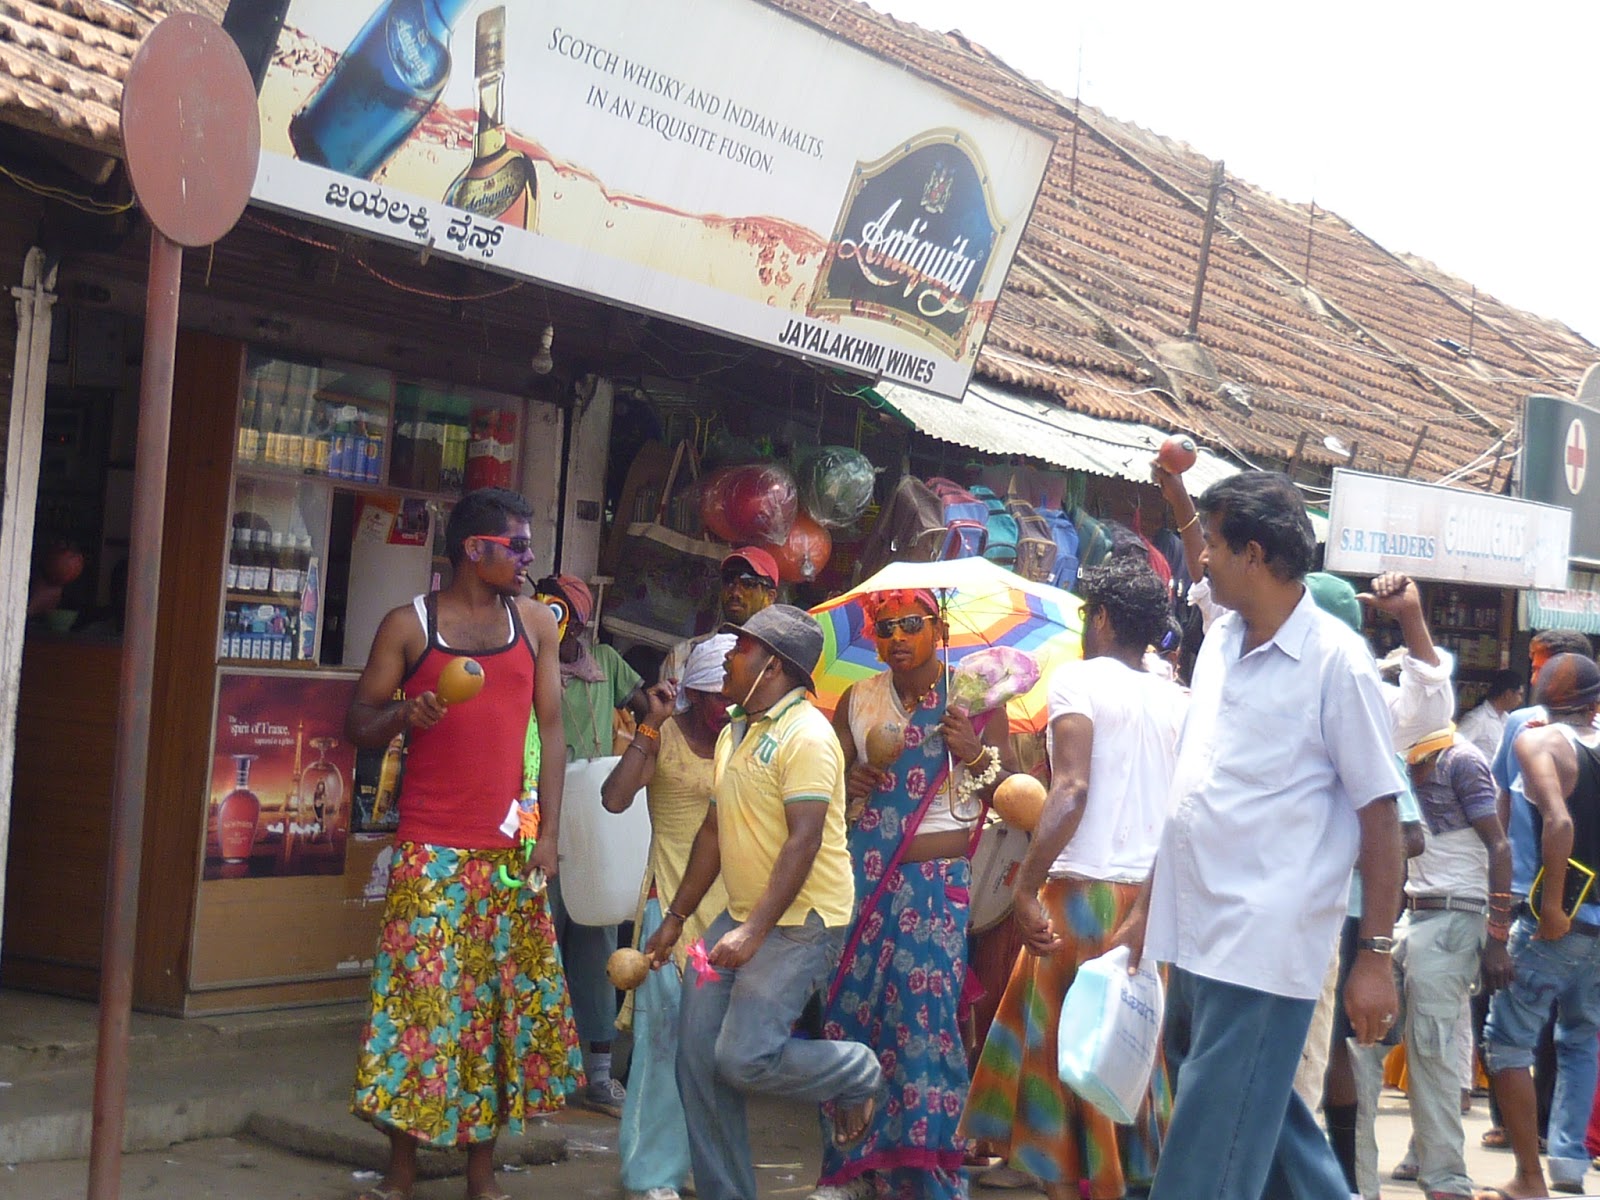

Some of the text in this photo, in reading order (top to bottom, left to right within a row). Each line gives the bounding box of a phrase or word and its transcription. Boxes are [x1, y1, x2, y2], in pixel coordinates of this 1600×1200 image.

[547, 27, 824, 160] SCOTCH WHISKY AND INDIAN MALTS,
[585, 85, 774, 175] IN AN EXQUISITE FUSION.
[838, 199, 976, 317] Antiquity
[779, 319, 937, 384] JAYALAKHMI WINES
[230, 721, 250, 737] spirit
[251, 721, 262, 735] of
